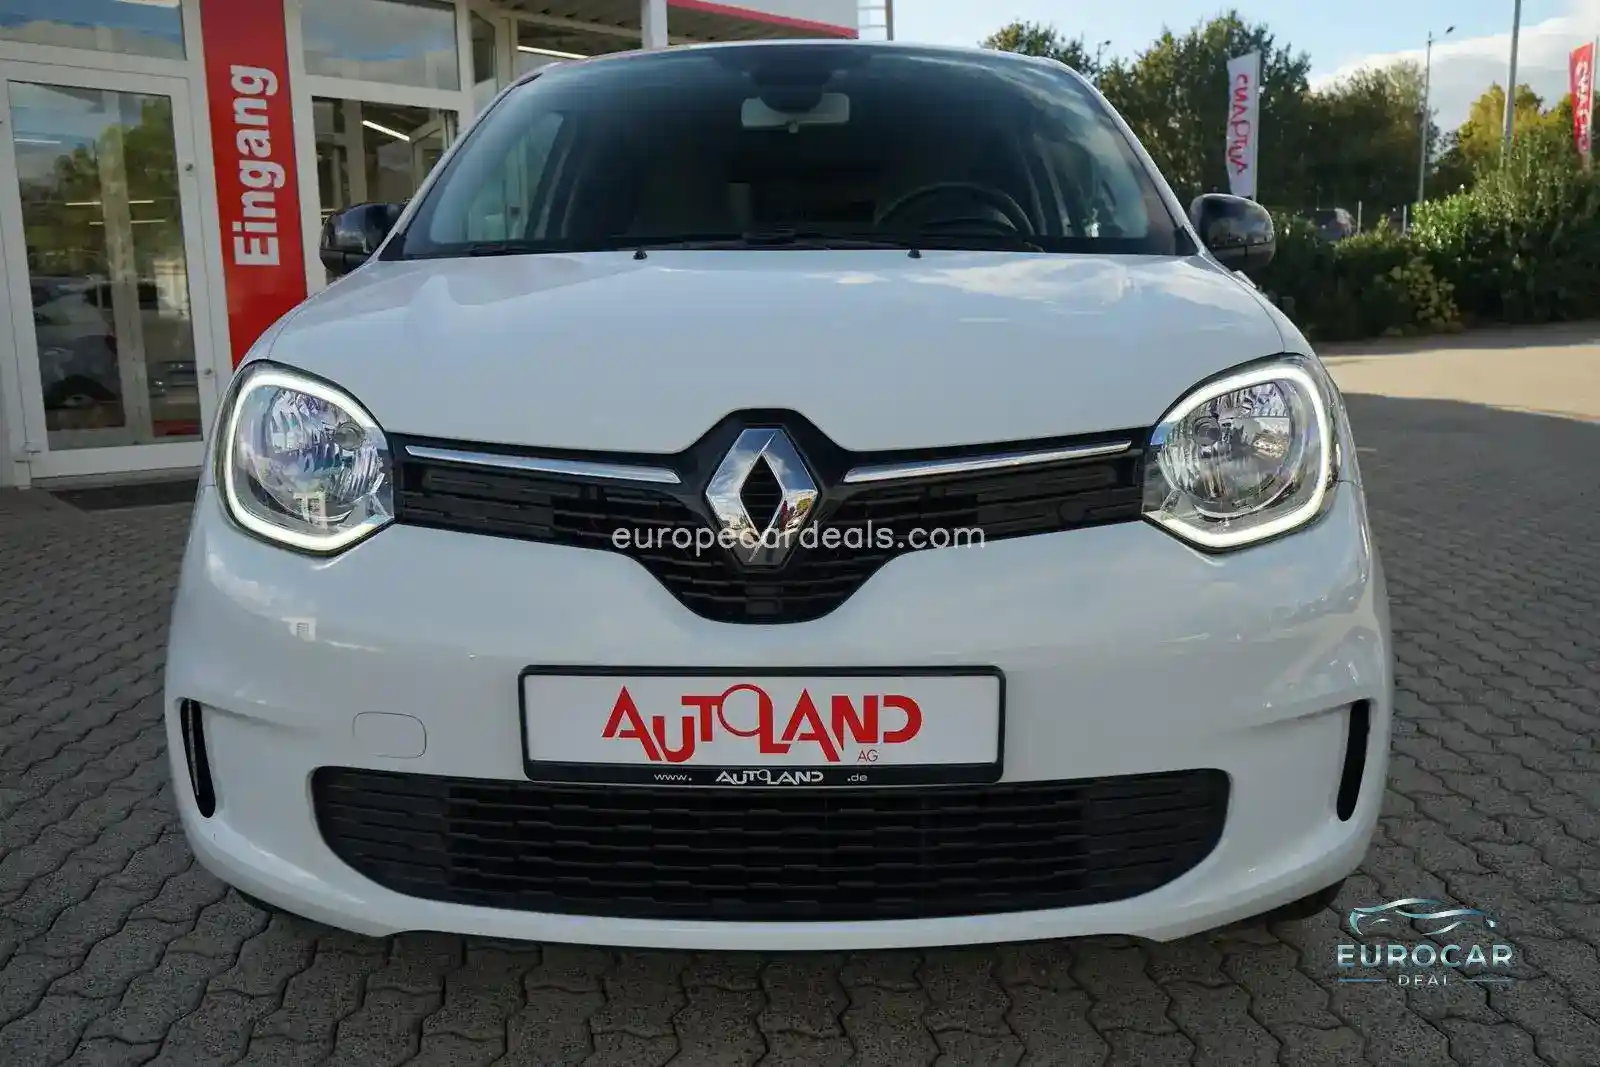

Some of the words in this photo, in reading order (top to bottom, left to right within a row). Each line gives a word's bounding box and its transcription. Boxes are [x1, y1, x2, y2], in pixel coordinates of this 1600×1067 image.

[230, 65, 286, 266] Eingang
[602, 683, 923, 763] AUTOLAND
[653, 773, 692, 781] www.
[715, 769, 824, 785] AUTOLAND
[847, 773, 868, 782] .de
[857, 749, 879, 762] AG
